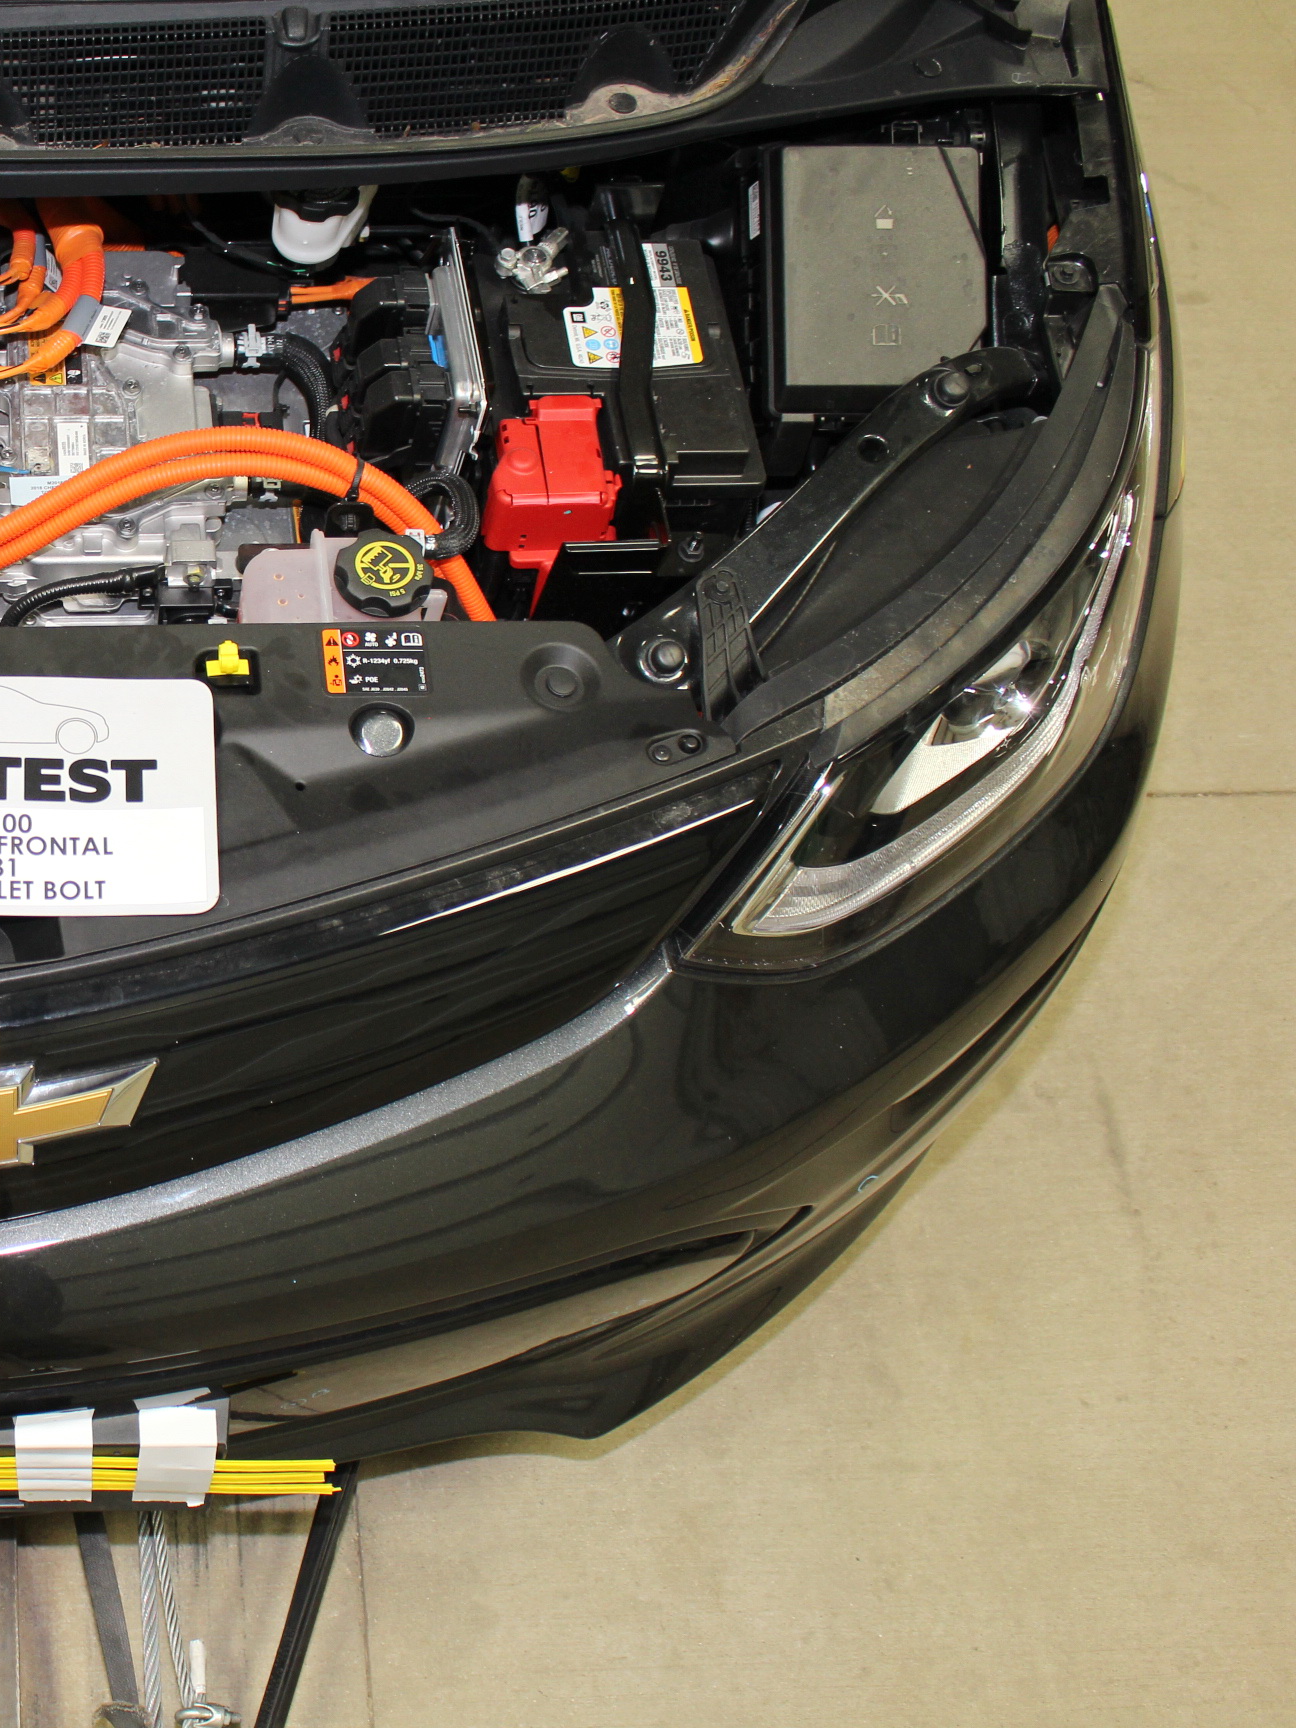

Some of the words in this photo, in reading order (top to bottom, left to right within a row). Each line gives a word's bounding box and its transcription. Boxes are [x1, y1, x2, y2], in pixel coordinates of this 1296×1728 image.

[656, 250, 672, 282] 9943
[415, 571, 423, 580] kPa
[44, 881, 106, 900] BOLT
